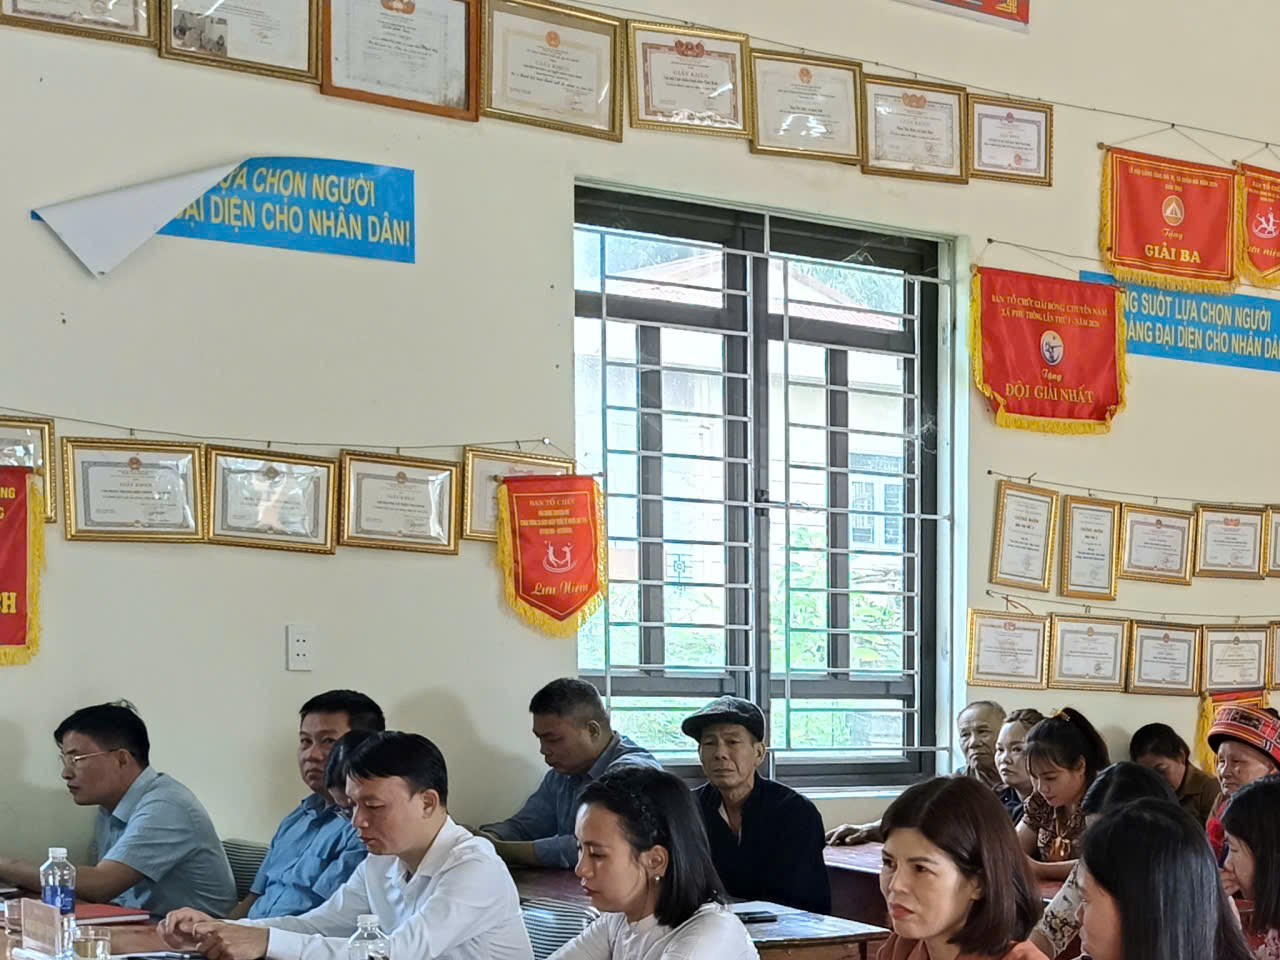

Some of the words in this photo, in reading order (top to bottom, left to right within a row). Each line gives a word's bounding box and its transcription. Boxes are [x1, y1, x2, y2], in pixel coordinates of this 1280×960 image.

[252, 168, 307, 202] CHỌN
[312, 173, 376, 207] NGƯỜI
[176, 196, 205, 228] ẠI
[261, 202, 303, 233] CHO
[309, 206, 362, 240] NHÂN
[368, 211, 411, 247] DÂN!
[1144, 241, 1176, 260] GIẢI
[1180, 248, 1201, 263] BA
[1175, 297, 1198, 326] LỰA
[1200, 301, 1232, 330] CHỌN
[1234, 306, 1272, 332] NGƯỜI
[1155, 323, 1175, 350] ĐẠI
[1205, 329, 1228, 353] CHO
[1231, 330, 1263, 358] NHÂN
[1005, 380, 1030, 400] ĐỘI
[1034, 383, 1057, 402] GIẢI
[1059, 383, 1094, 404] NHẤT
[0, 591, 17, 614] H
